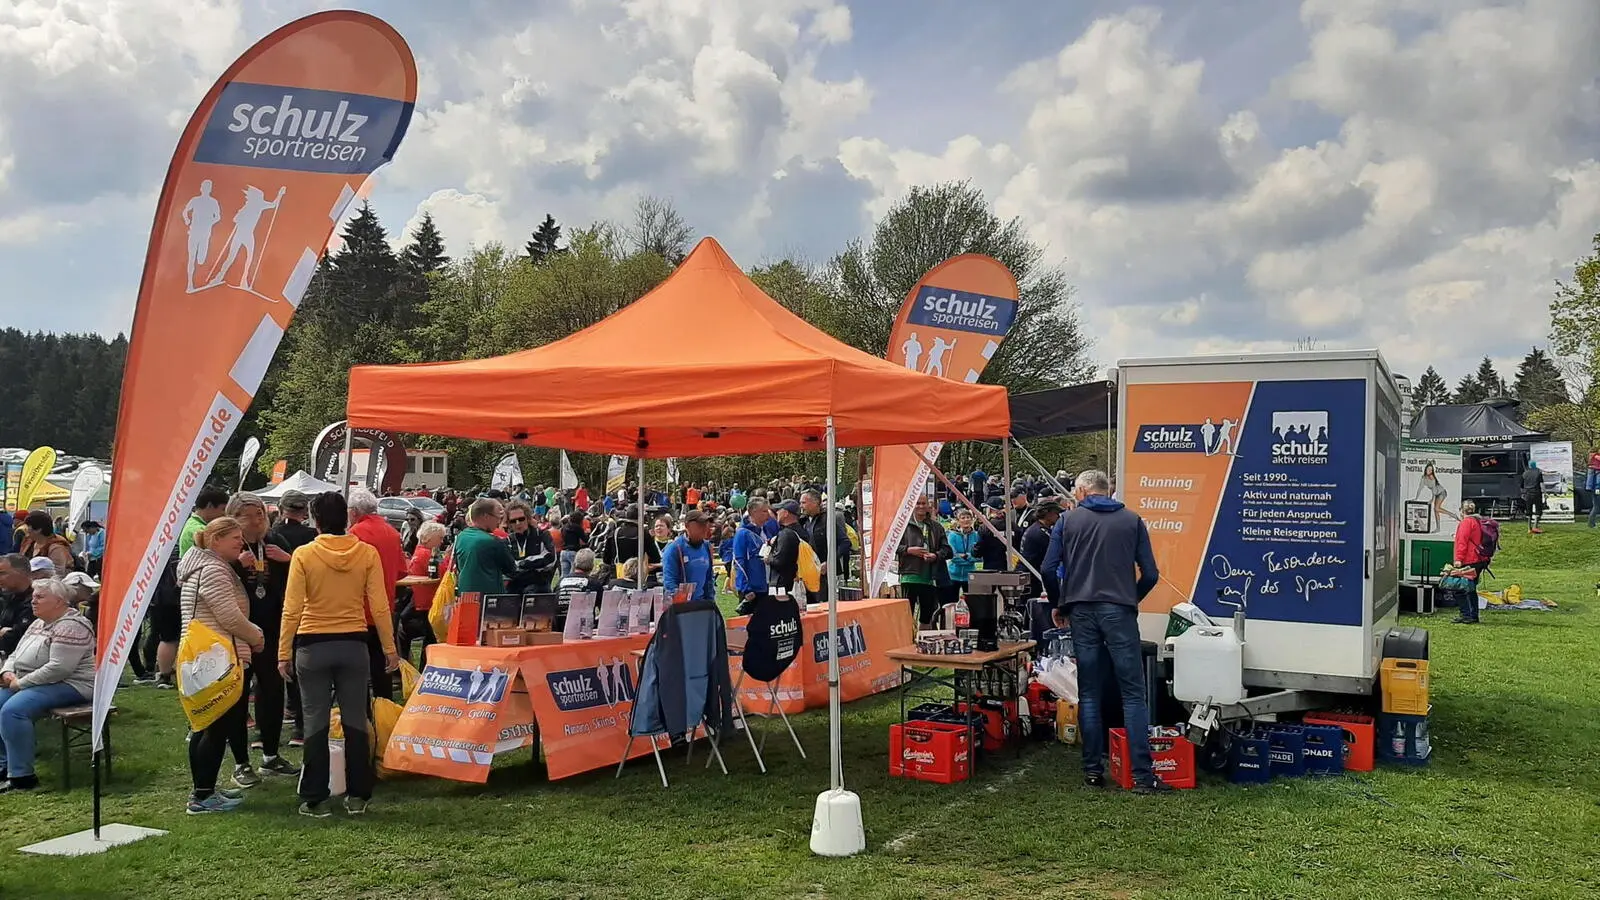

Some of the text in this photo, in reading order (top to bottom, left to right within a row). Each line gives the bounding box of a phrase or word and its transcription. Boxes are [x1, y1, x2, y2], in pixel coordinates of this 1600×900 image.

[228, 95, 369, 143] schulz
[243, 136, 367, 162] sportreisen
[923, 293, 997, 319] schulz
[931, 312, 999, 330] sportreisen
[1143, 427, 1193, 442] schulz
[1150, 440, 1196, 450] sportreisen
[1272, 440, 1328, 455] schulz
[1272, 455, 1328, 464] aktiv reisen
[1140, 475, 1193, 490] Running
[1243, 473, 1261, 481] Seit
[1263, 473, 1287, 481] 1990
[1243, 491, 1332, 500] Aktiv und naturnah
[1140, 497, 1178, 512] Skiing
[1243, 508, 1332, 519] Für jeden Anspruch
[109, 407, 232, 666] www.schulz-sportreisen.de
[1242, 527, 1337, 538] Kleine Reisegruppen
[1211, 551, 1346, 580] Dem Besonderen
[1223, 576, 1252, 607] auf
[552, 674, 594, 696] schulz
[560, 689, 599, 707] sportreisen
[468, 709, 497, 721] Cycling
